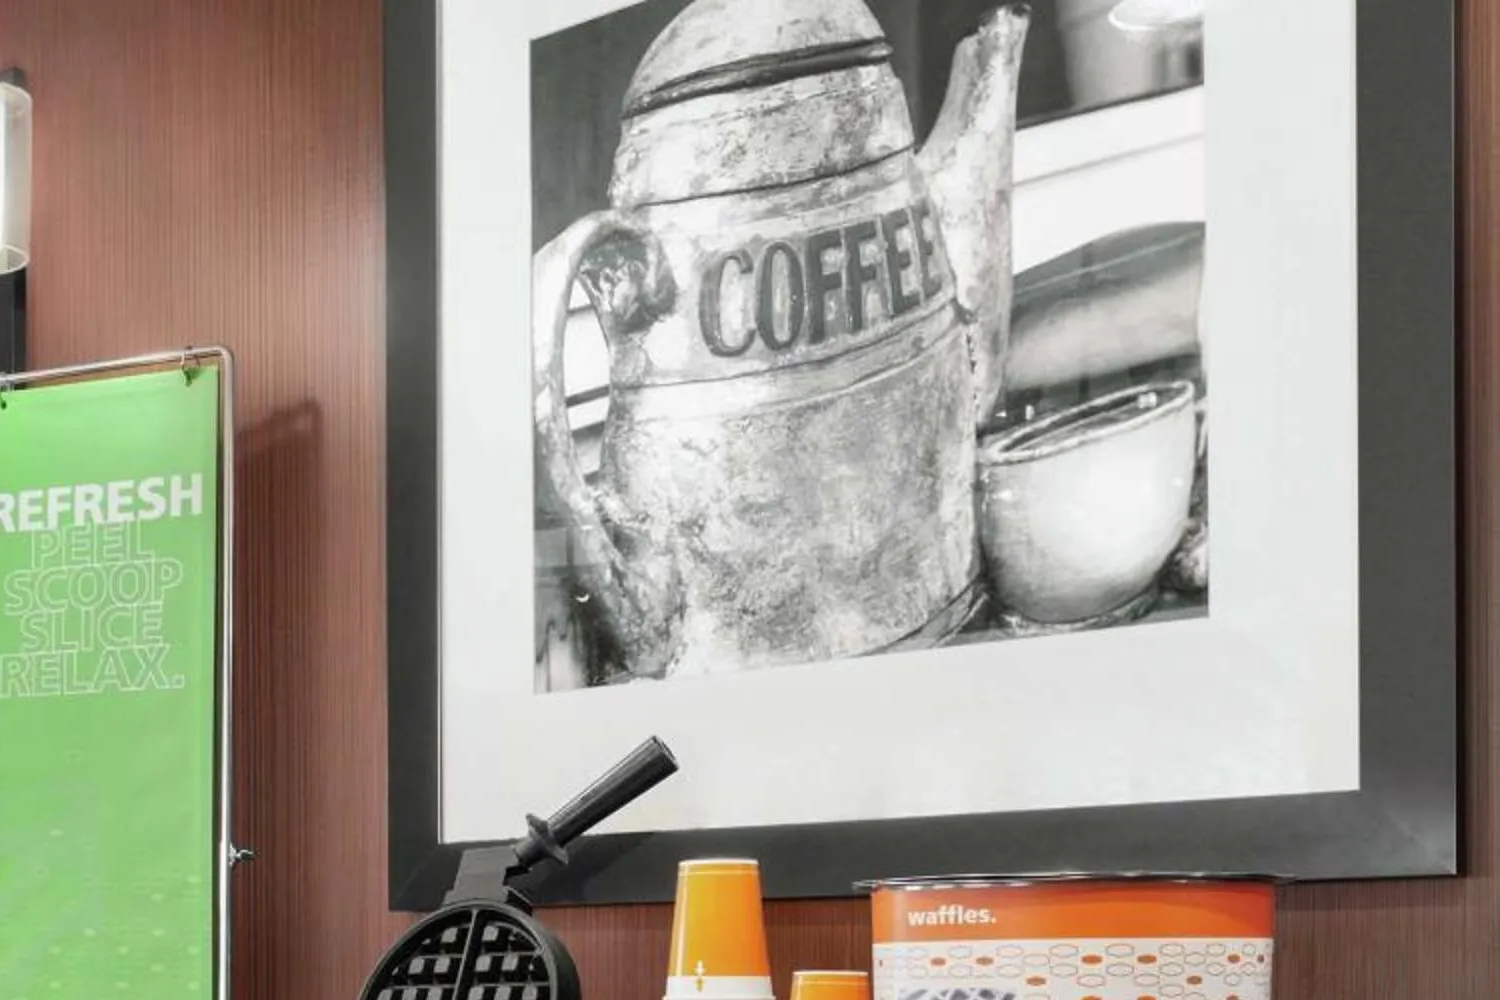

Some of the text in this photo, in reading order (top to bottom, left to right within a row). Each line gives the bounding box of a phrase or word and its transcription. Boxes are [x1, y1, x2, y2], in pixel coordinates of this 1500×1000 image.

[699, 200, 942, 357] COFFEE
[31, 519, 154, 570] PEEL
[3, 558, 183, 615] SCOOP
[20, 602, 163, 652] SLICE
[0, 644, 185, 698] RELAX.
[907, 904, 997, 926] waffles.
